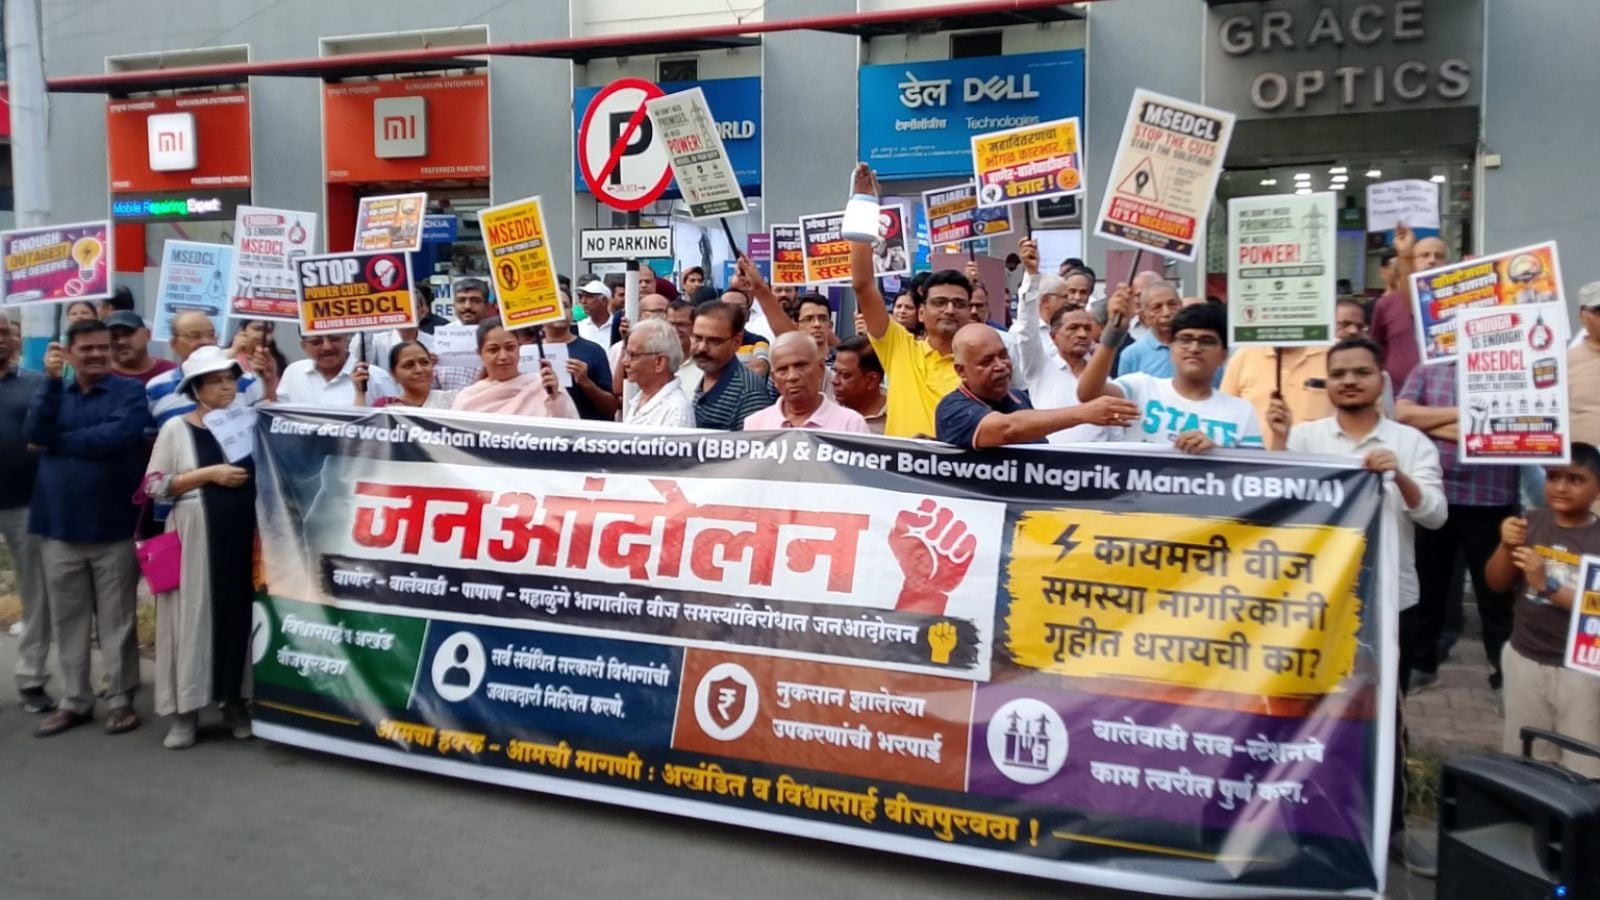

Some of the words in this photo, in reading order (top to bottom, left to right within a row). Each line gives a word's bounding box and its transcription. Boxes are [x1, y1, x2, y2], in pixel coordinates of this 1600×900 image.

[1218, 0, 1426, 56] GRACE
[898, 71, 952, 109] डेल
[963, 73, 1040, 103] DELL
[1250, 58, 1471, 110] OPTICS
[714, 120, 757, 140] RLD
[965, 116, 1039, 130] Technologies
[1143, 104, 1215, 140] MSEDCL
[666, 133, 703, 155] POWER!
[1131, 138, 1155, 151] START
[1134, 125, 1163, 143] STOP
[1165, 132, 1185, 148] THE
[929, 187, 972, 208] RELIABLE
[1004, 176, 1046, 197] बेजार
[113, 200, 142, 215] Mobile
[143, 199, 187, 216] Repairing
[187, 198, 221, 214] Expert
[10, 231, 62, 255] ENOUGH
[488, 215, 541, 246] MSEDCL
[932, 224, 971, 243] LUXURY!
[239, 237, 285, 257] MSEDCL
[587, 237, 605, 252] NO
[609, 235, 668, 251] PARKING
[1239, 243, 1301, 265] POWER!
[170, 248, 215, 266] MSEDCL
[12, 267, 28, 280] WE
[301, 258, 359, 288] STOP
[304, 285, 340, 299] POWER
[341, 282, 370, 296] CUTS!
[313, 295, 404, 319] MSEDCL
[314, 318, 345, 330] DELIVER
[345, 316, 378, 327] RELIABLE
[1472, 314, 1512, 334] ENOUGH
[1471, 337, 1480, 350] IS
[1482, 329, 1524, 349] ENOUGH!
[1467, 350, 1527, 373] MSEDCL
[269, 416, 316, 436] Baner
[406, 425, 476, 448] Pashan
[478, 429, 569, 453] Residents
[572, 436, 693, 458] Association
[697, 438, 787, 464] (BBPRA)
[793, 444, 810, 461] &
[817, 443, 892, 470] Baner
[898, 452, 1018, 483] Balewadi
[1025, 463, 1121, 492] Nagrik
[1126, 468, 1226, 497] Manch
[1231, 472, 1346, 509] (BBNM)
[351, 476, 871, 594] जनआंदोलन
[1093, 534, 1231, 577] कायमची
[1243, 539, 1315, 584] वीज
[333, 566, 374, 589] बाणेर
[388, 571, 449, 597] बालेवाडी
[462, 581, 504, 602] पाषाण
[519, 586, 570, 614] महाळुंगे
[574, 588, 644, 616] भागातील
[646, 596, 679, 620] वीज
[683, 602, 808, 634] समस्यांविरोधात
[813, 613, 920, 645] जनआंदोलन
[1041, 575, 1149, 615] समस्या
[1157, 584, 1330, 631] नागरिकांनी
[354, 626, 397, 651] अखंड
[1044, 616, 1123, 664] गृहीत
[1133, 631, 1251, 672] धरायची
[1262, 642, 1323, 680] का?
[276, 643, 350, 678] वीजपुरवठा
[490, 643, 514, 668] सर्व
[513, 645, 557, 674] संबंधित
[557, 655, 606, 681] सरकारी
[606, 656, 672, 689] विभागांची
[543, 683, 590, 713] निश्चित
[589, 692, 626, 719] करणे.
[776, 680, 846, 710] नुकसान
[849, 685, 928, 718] झालेल्या
[772, 718, 873, 751] उपकरणांची
[877, 731, 944, 764] भरपाई
[1091, 716, 1189, 753] बालेवाडी
[1192, 731, 1326, 765] सब-स्टेशनचे
[376, 718, 435, 749] आमचा
[437, 727, 486, 756] हक्क
[505, 739, 572, 770] आमची
[574, 751, 643, 781] मागणी
[662, 760, 747, 798] अखंडित
[751, 776, 770, 801] व
[884, 793, 1020, 842] वीजपुरवठा
[1089, 761, 1141, 789] काम
[1145, 769, 1214, 800] त्वरीत
[1217, 772, 1255, 811] पुर्ण
